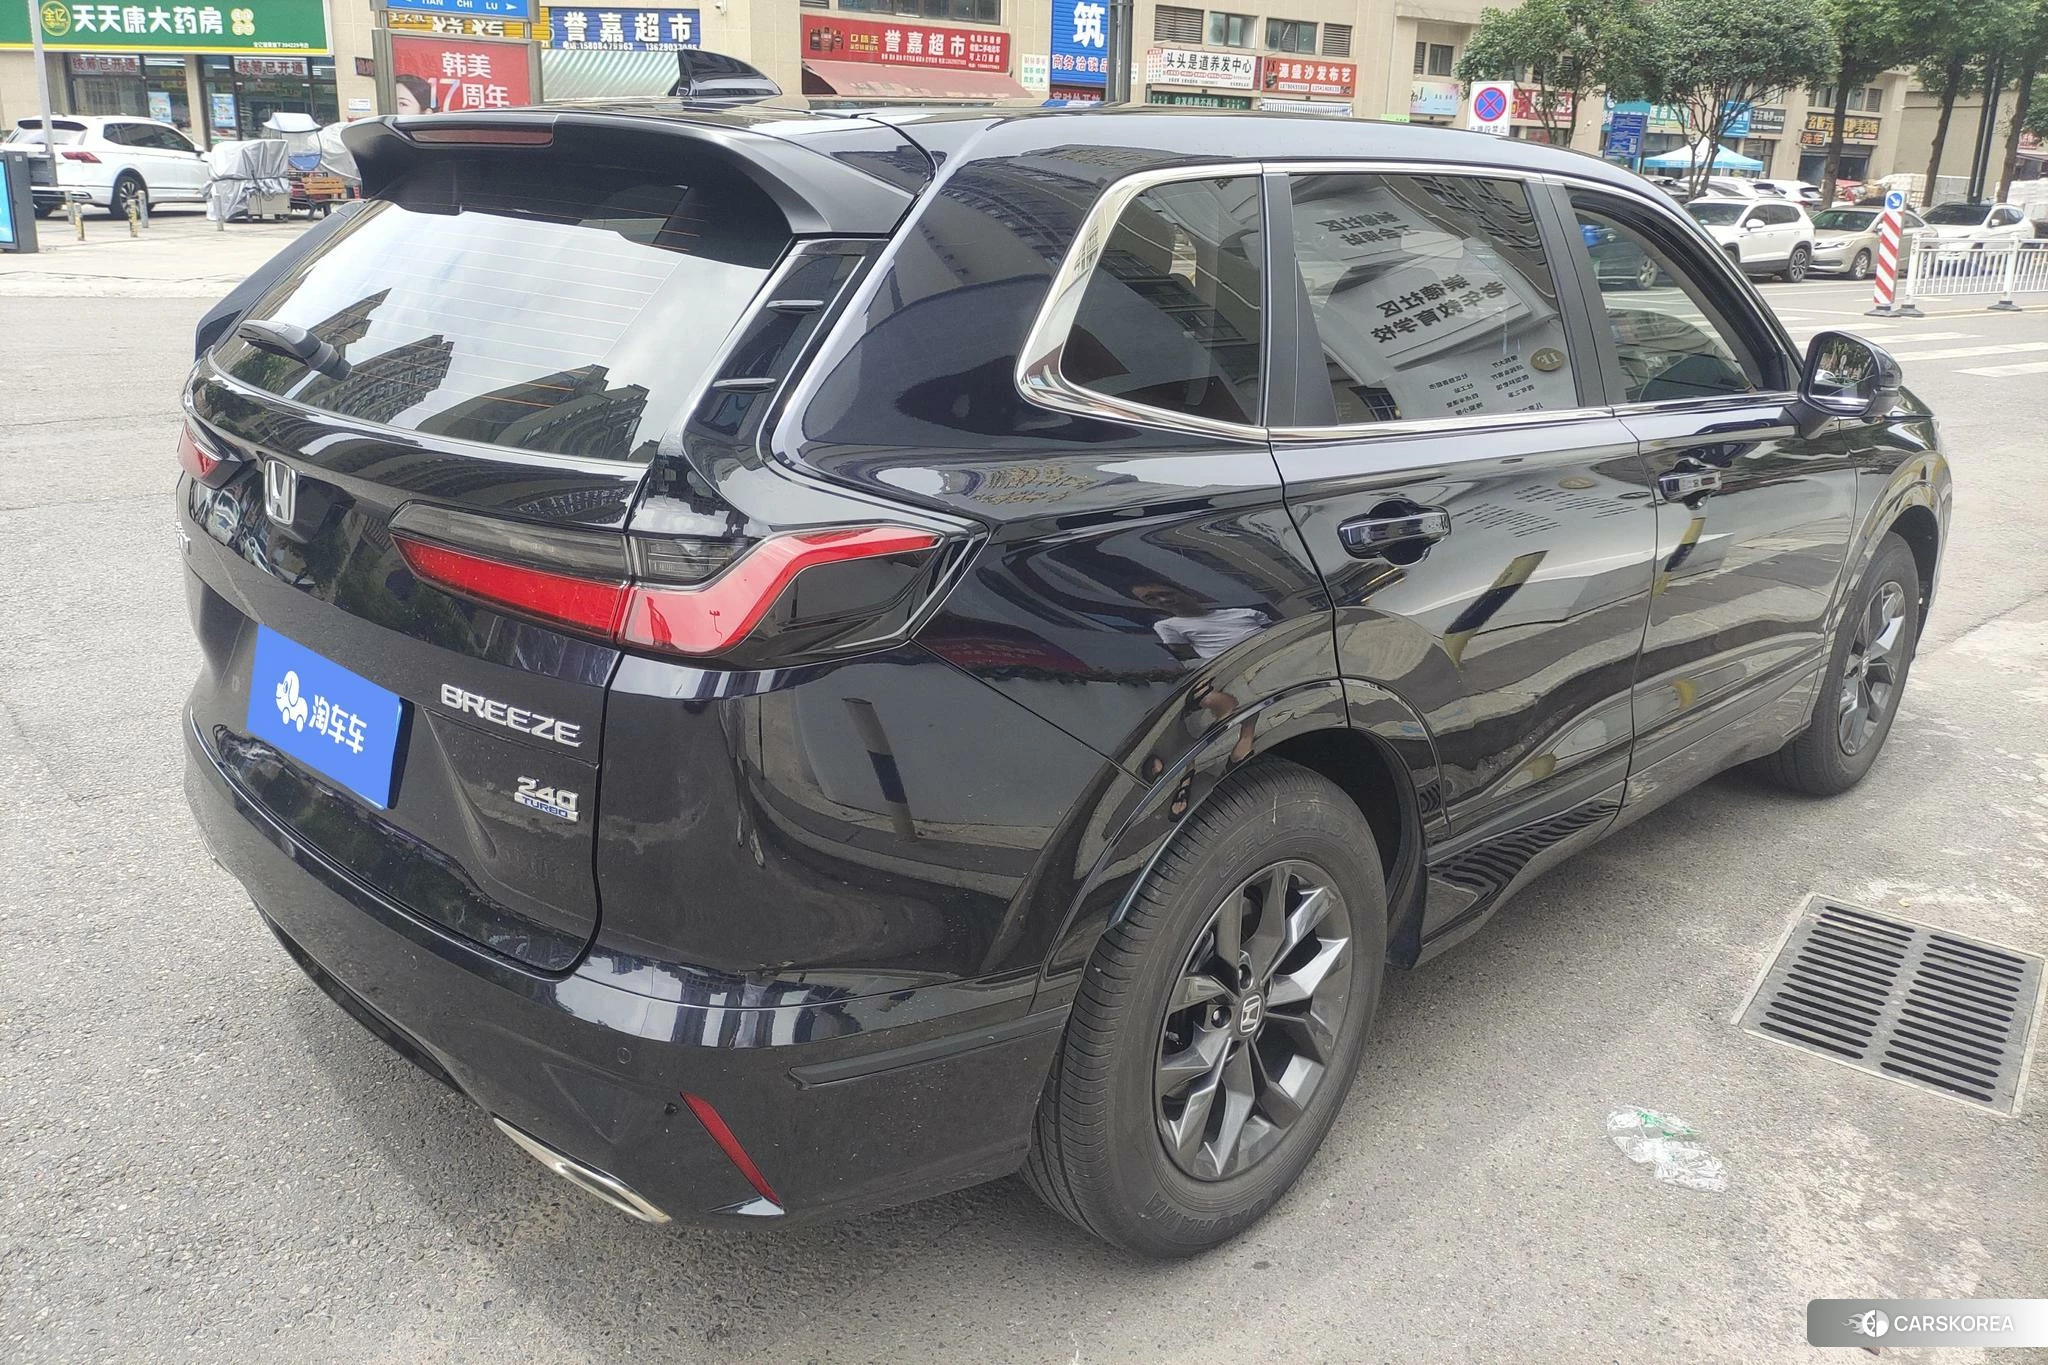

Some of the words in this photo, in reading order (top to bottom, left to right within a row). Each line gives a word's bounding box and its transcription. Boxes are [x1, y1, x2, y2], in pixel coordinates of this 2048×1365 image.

[456, 0, 474, 9] CHI
[485, 2, 499, 10] LU
[72, 5, 224, 35] 天天康大药房
[564, 11, 692, 43] 誉嘉超市
[1073, 2, 1105, 48] 筑
[885, 29, 966, 58] 誉嘉超市
[441, 51, 492, 79] 韩美
[1166, 51, 1252, 74] 头头是道养发中心
[1279, 62, 1352, 83] 源盛沙发布艺
[428, 77, 511, 112] 17周年
[441, 683, 583, 748] BREEZE
[517, 776, 580, 812] 240
[521, 795, 569, 819] TURBO
